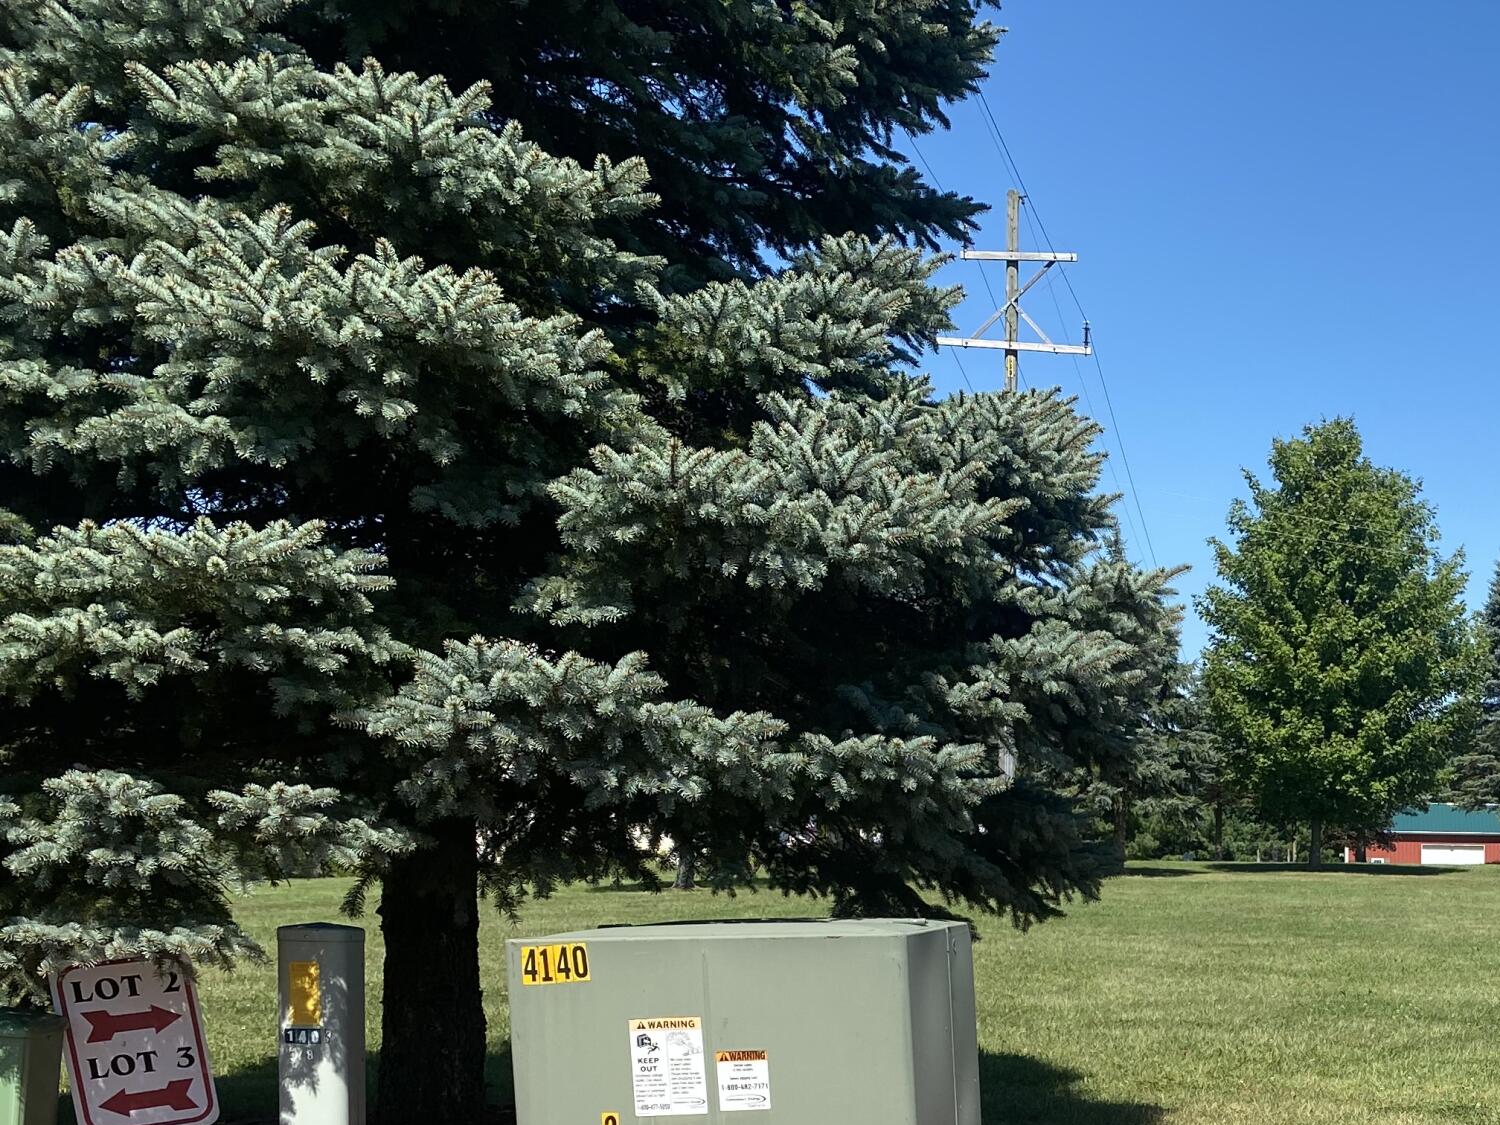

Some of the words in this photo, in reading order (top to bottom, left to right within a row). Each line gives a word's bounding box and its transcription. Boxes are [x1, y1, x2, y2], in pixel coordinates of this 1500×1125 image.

[524, 945, 589, 982] 4140
[70, 974, 143, 1003] LOT
[163, 971, 181, 993] 2
[647, 1019, 696, 1030] WARNING
[86, 1050, 159, 1080] LOT
[176, 1046, 195, 1069] 3
[728, 1050, 766, 1061] WARNING
[640, 1065, 658, 1073] OUT
